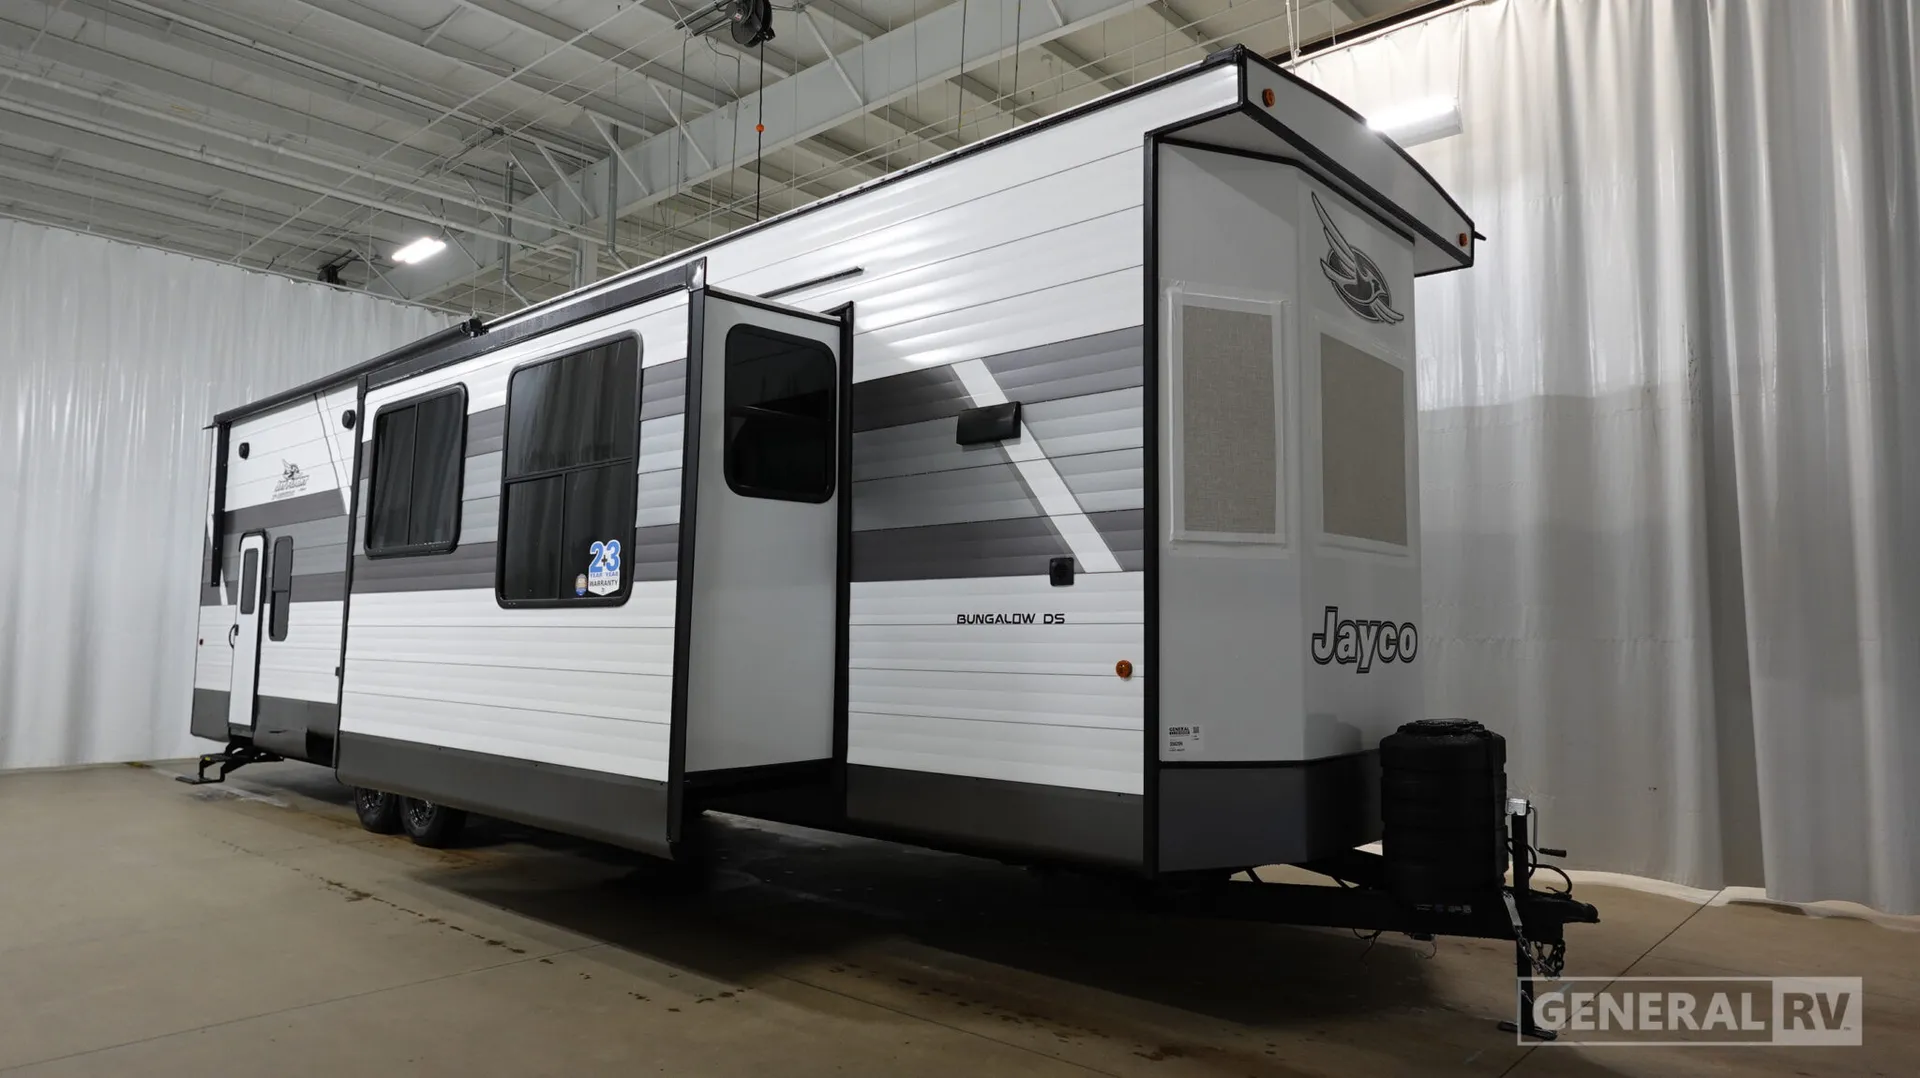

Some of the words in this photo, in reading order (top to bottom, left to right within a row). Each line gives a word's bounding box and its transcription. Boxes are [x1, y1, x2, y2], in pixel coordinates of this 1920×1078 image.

[590, 579, 618, 587] WARRANTY
[956, 613, 1036, 625] BUNGALOW
[1043, 613, 1066, 625] DS
[1311, 605, 1418, 674] Jayco
